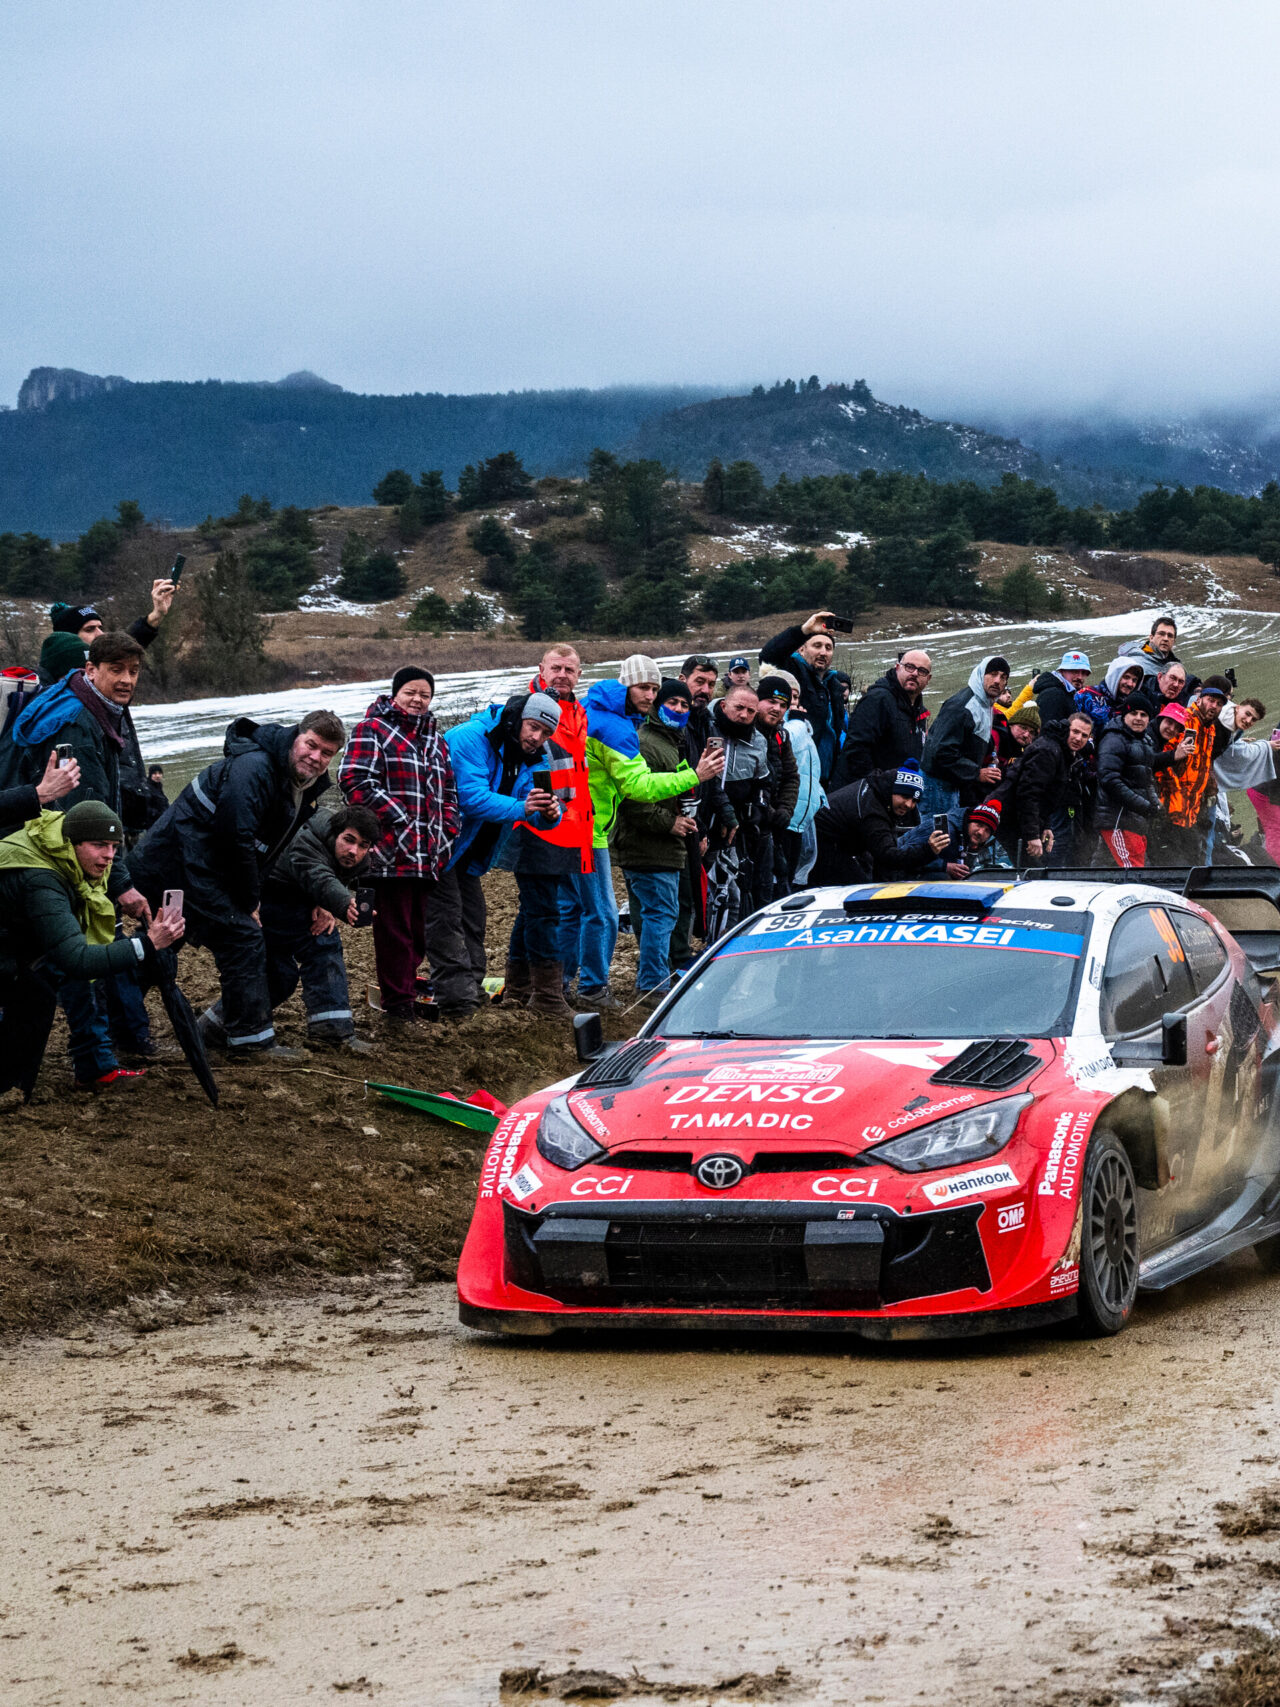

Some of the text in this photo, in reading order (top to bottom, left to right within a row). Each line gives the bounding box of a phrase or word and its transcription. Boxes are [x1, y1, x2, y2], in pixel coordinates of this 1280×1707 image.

[764, 913, 807, 933] 99
[815, 913, 1055, 930] TOYOTA GAZOO Racing
[1148, 908, 1185, 964] 99
[711, 1067, 748, 1080] RALLYE
[1078, 1056, 1114, 1078] TAMADIC
[664, 1084, 846, 1105] DENSO
[669, 1112, 814, 1130] TAMADIC
[480, 1111, 521, 1198] AUTOMOTIVE
[496, 1111, 541, 1195] Panasonic
[1038, 1111, 1074, 1196] Panasonic
[1059, 1111, 1092, 1199] AUTOMOTIVE
[997, 1206, 1025, 1229] OMP
